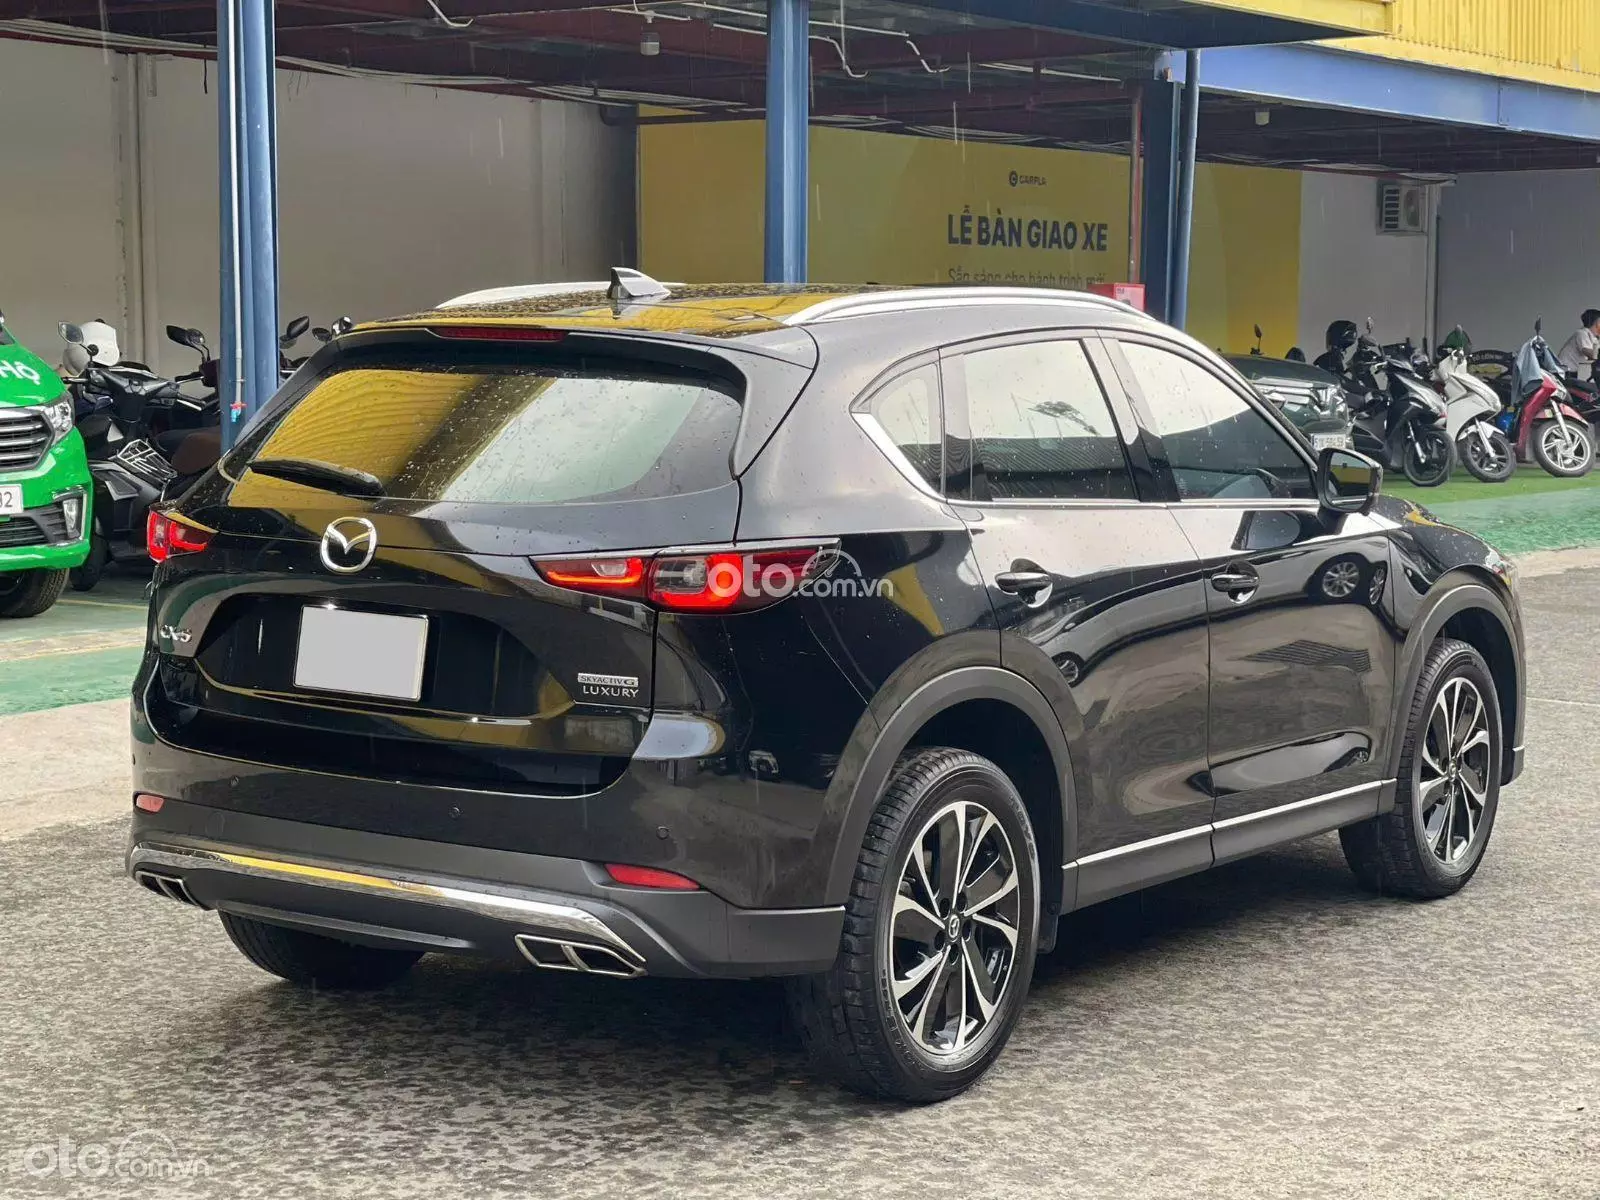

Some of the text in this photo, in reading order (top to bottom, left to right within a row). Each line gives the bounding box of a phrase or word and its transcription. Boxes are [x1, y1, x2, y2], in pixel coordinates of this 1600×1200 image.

[948, 205, 1108, 251] LỄ BÀN GIAO XE
[160, 624, 192, 643] CX-5
[582, 685, 640, 698] LUXURY
